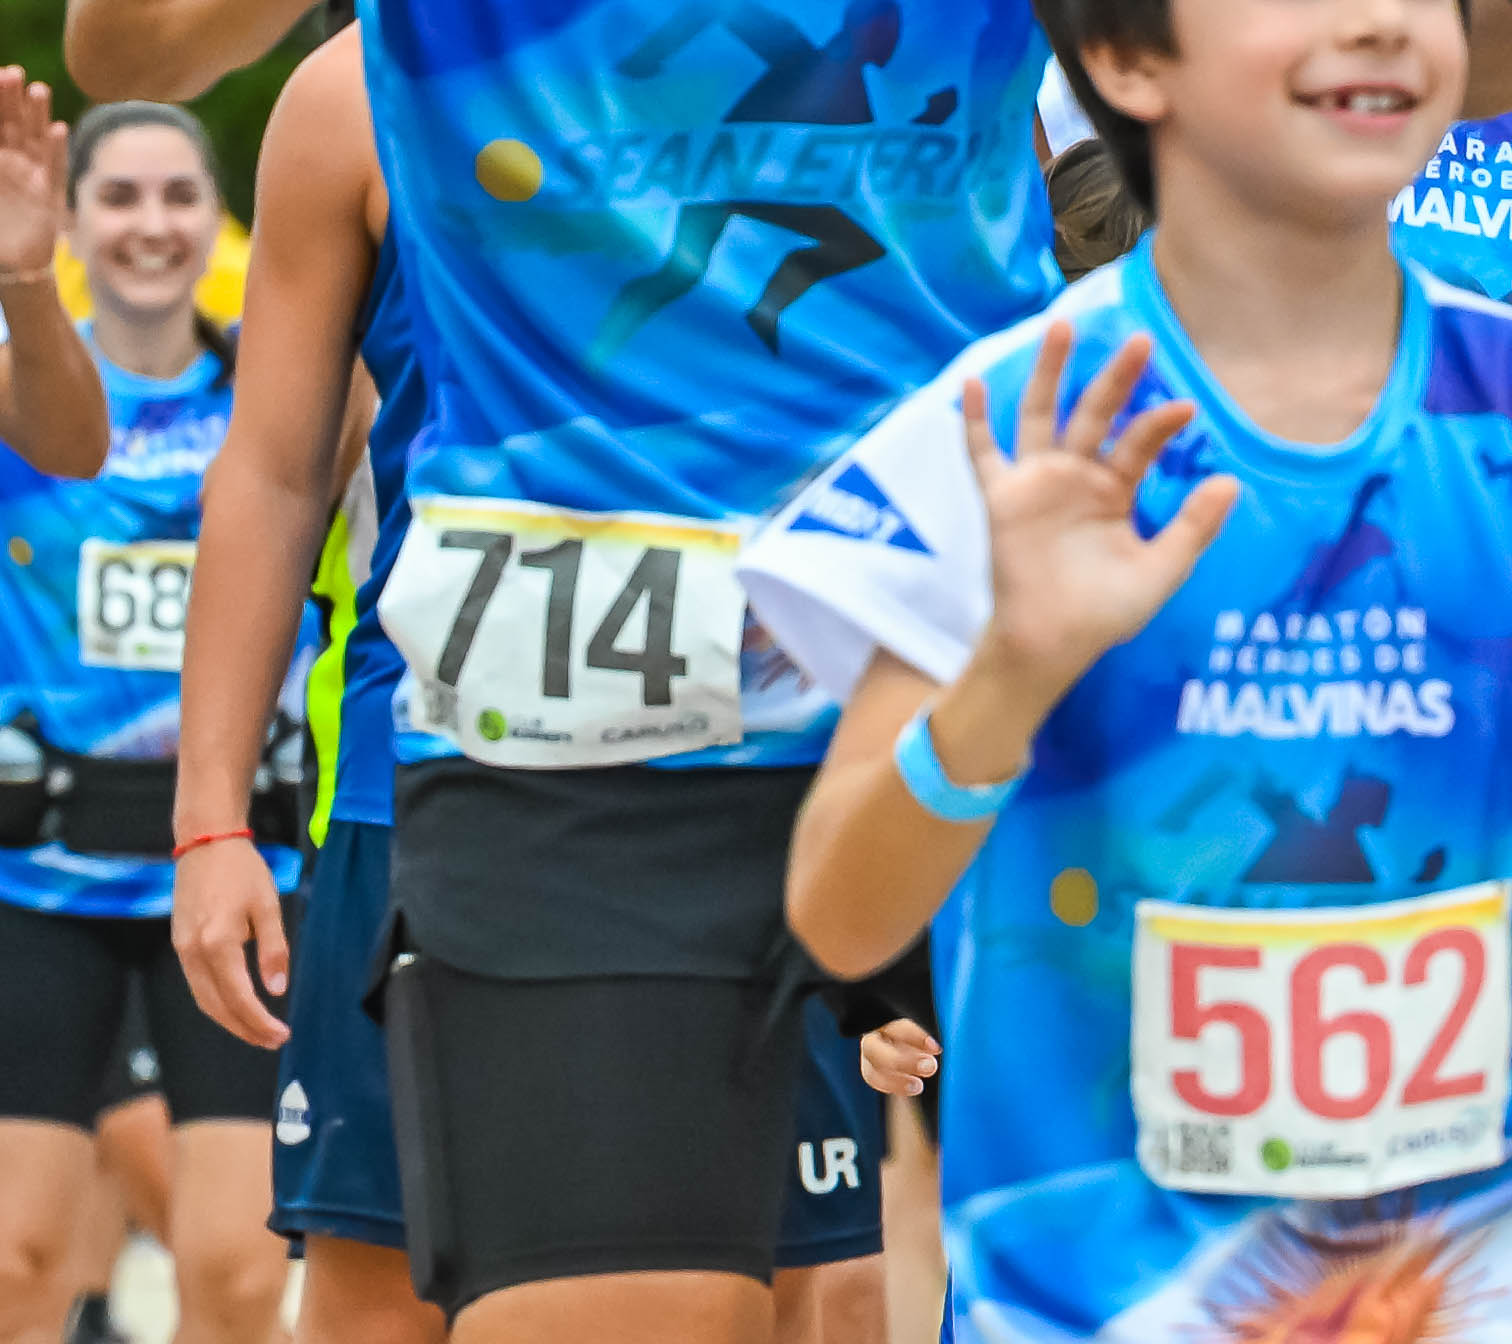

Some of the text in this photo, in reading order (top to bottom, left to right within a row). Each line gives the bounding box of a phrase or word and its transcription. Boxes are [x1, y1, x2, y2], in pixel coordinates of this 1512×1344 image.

[438, 530, 688, 706] 714
[1176, 678, 1457, 738] MALVINAS
[1169, 924, 1489, 1121] 562
[798, 1137, 860, 1195] UR
